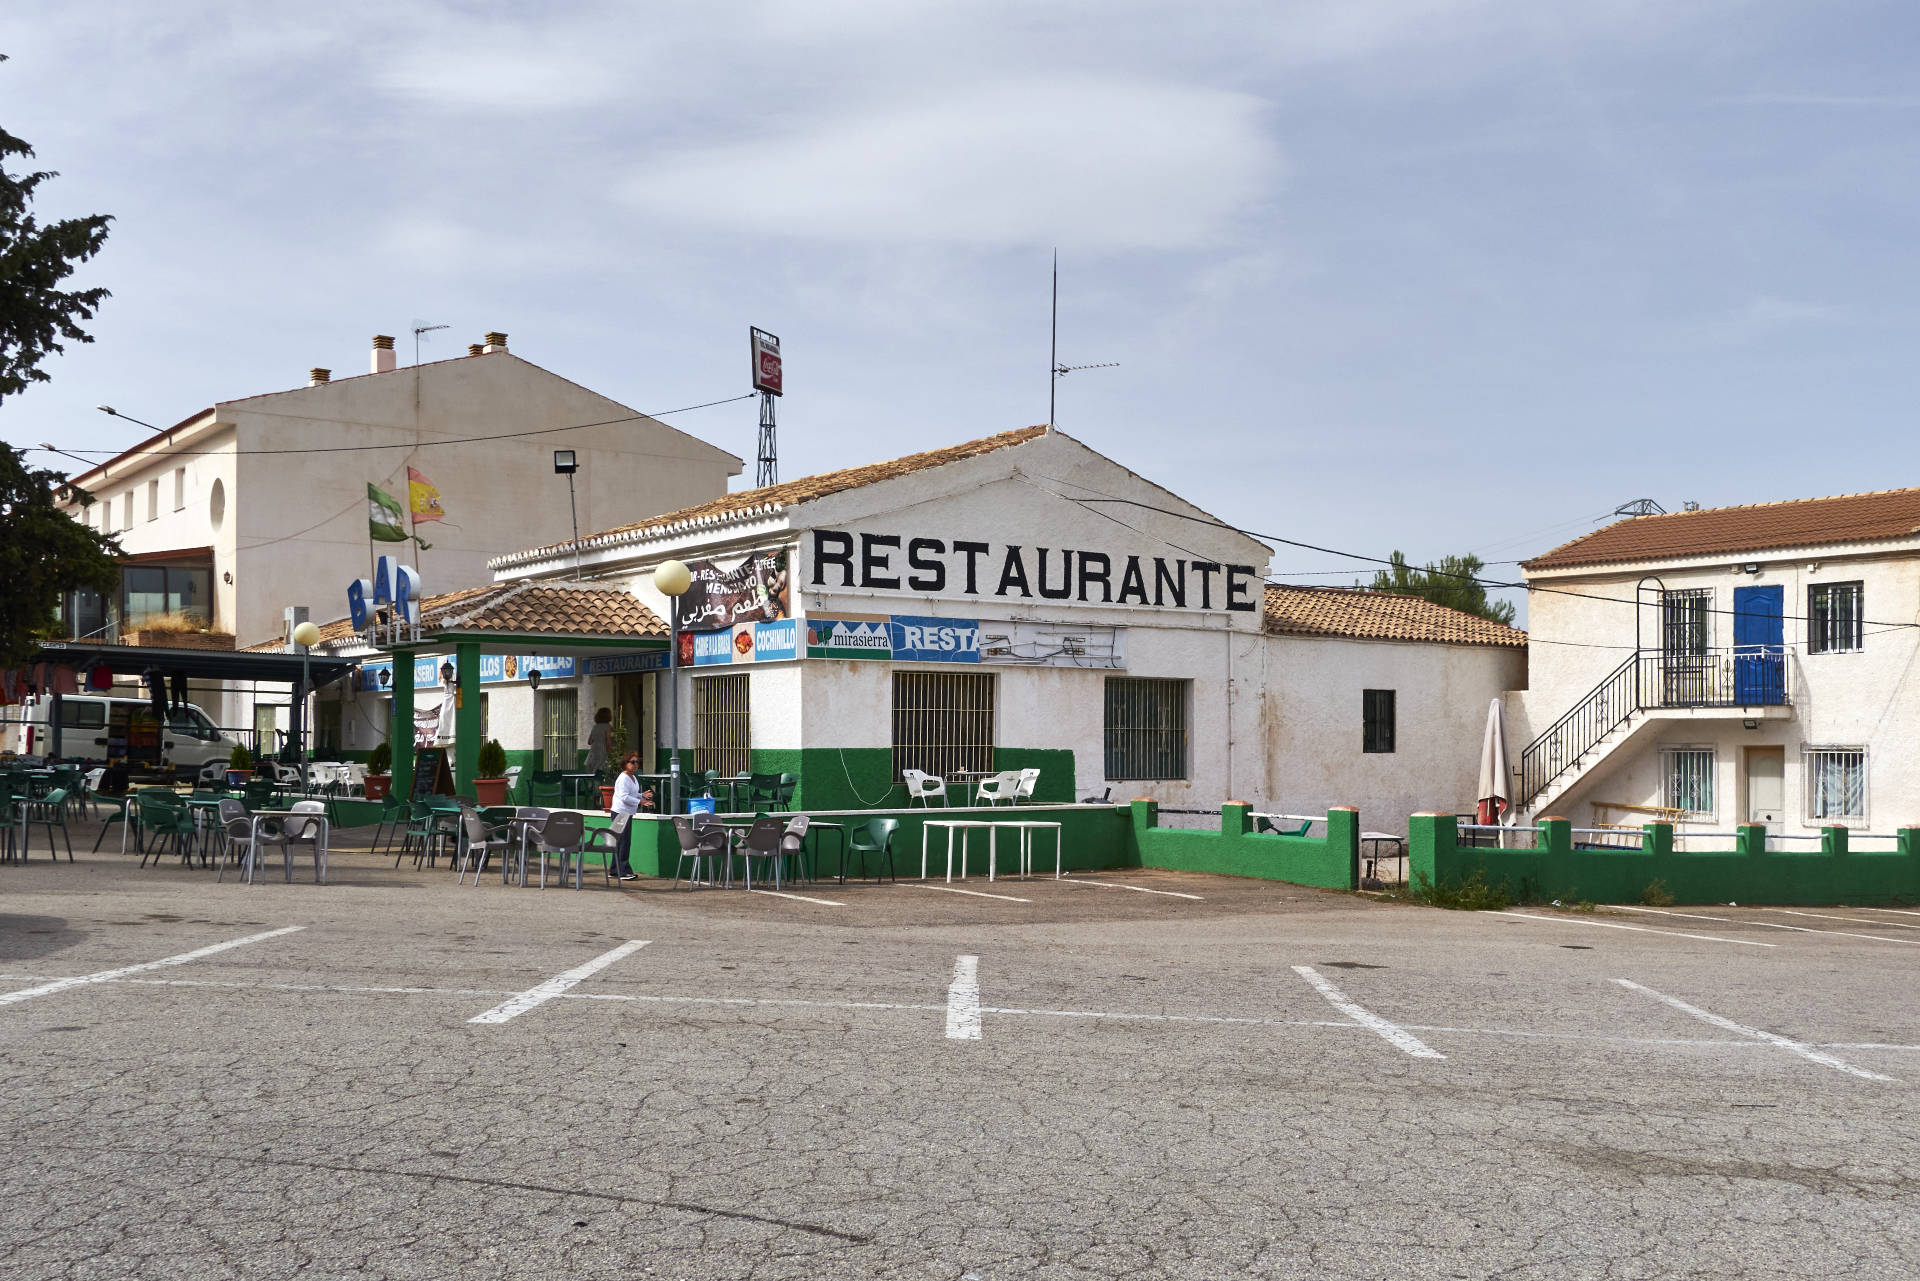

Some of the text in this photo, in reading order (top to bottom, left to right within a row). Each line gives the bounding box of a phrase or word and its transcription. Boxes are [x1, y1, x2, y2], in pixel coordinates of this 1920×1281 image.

[811, 529, 1256, 612] RESTAURANTE
[347, 555, 420, 632] BAR
[756, 628, 795, 652] COCHINILLO
[834, 630, 889, 648] mirasierra
[522, 655, 573, 672] PAELLAS
[588, 653, 663, 673] RESTAURANTE
